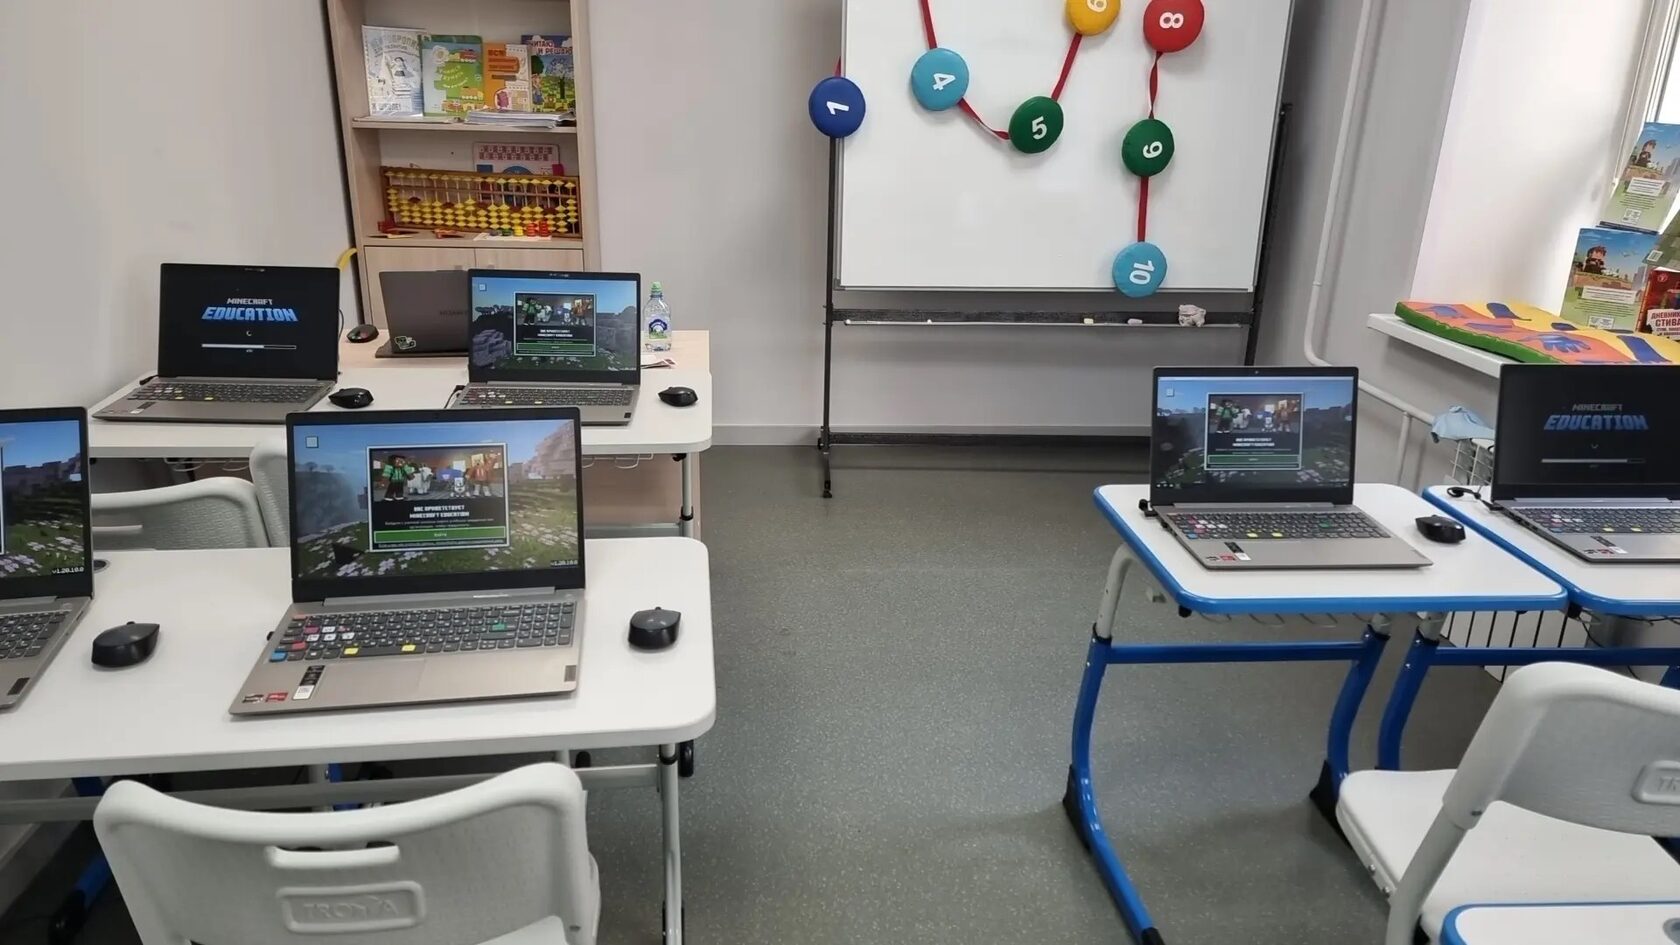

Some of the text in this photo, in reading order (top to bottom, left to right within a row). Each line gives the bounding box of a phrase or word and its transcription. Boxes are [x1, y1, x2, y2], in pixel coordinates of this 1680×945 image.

[1159, 11, 1185, 29] 8
[932, 72, 956, 91] 4
[826, 100, 850, 115] 1
[1031, 115, 1048, 140] 5
[1142, 140, 1163, 159] 9
[1129, 259, 1155, 285] 10
[226, 297, 273, 306] MINECRAFT
[201, 305, 299, 322] EDUCATION
[1571, 403, 1624, 412] MINECRAFT
[1543, 414, 1649, 431] EDUCATION
